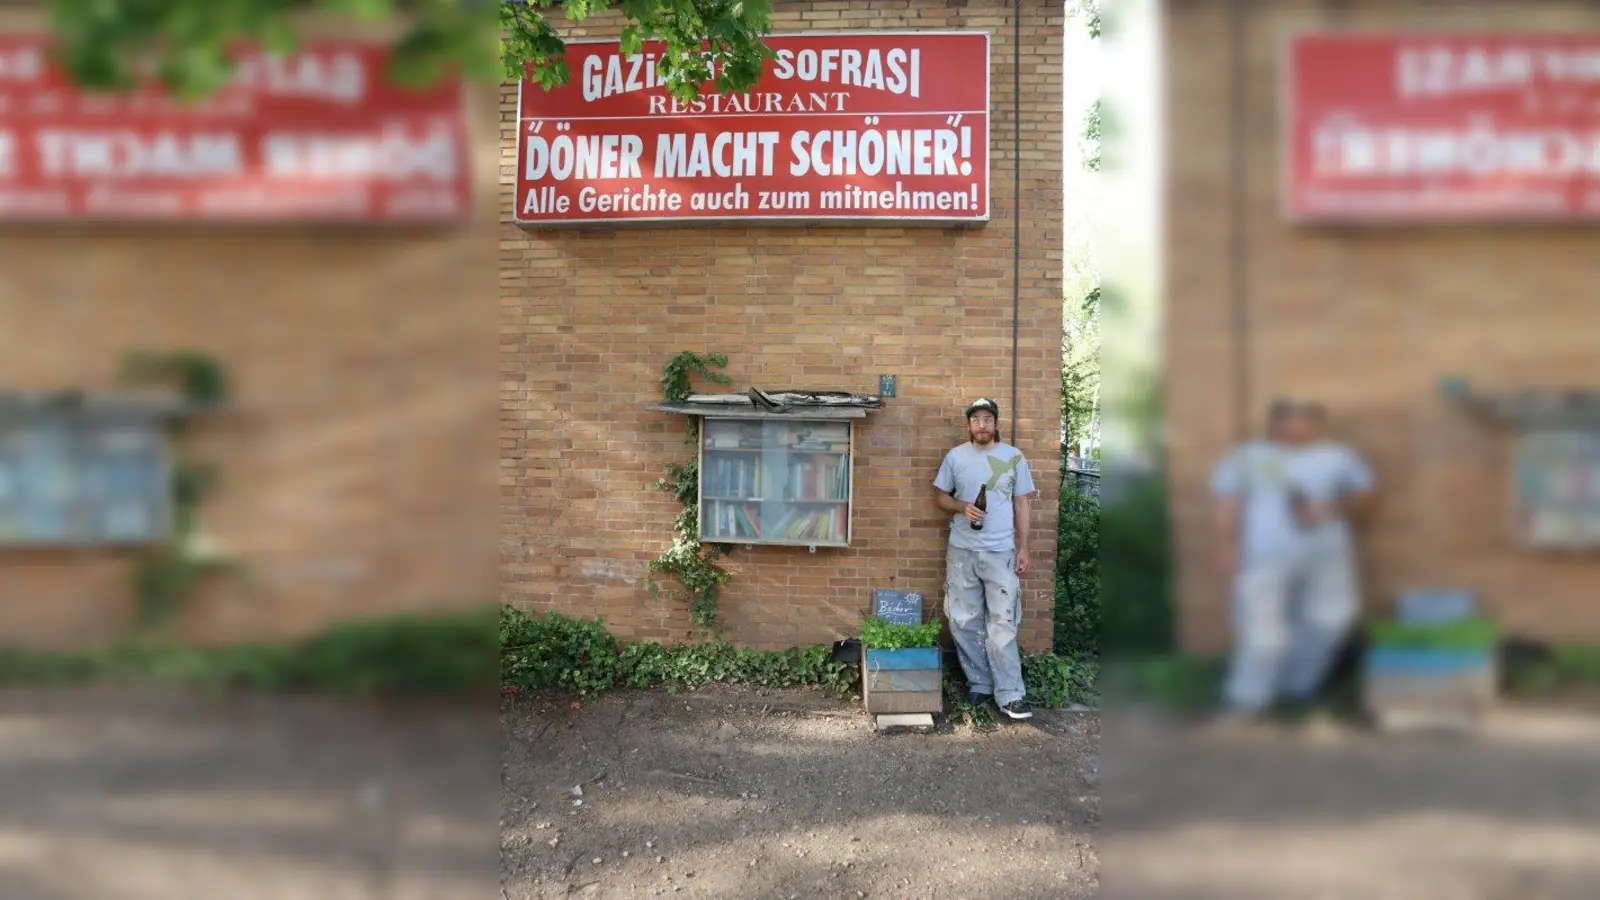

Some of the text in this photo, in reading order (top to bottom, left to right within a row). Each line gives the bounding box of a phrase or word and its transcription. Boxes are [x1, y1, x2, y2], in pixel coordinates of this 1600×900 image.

[773, 48, 920, 98] SOFRASI
[649, 92, 851, 115] RESTAURANT
[653, 131, 780, 178] MACHT
[522, 180, 978, 214] Alle Gerichte auch zum mitnehmen!
